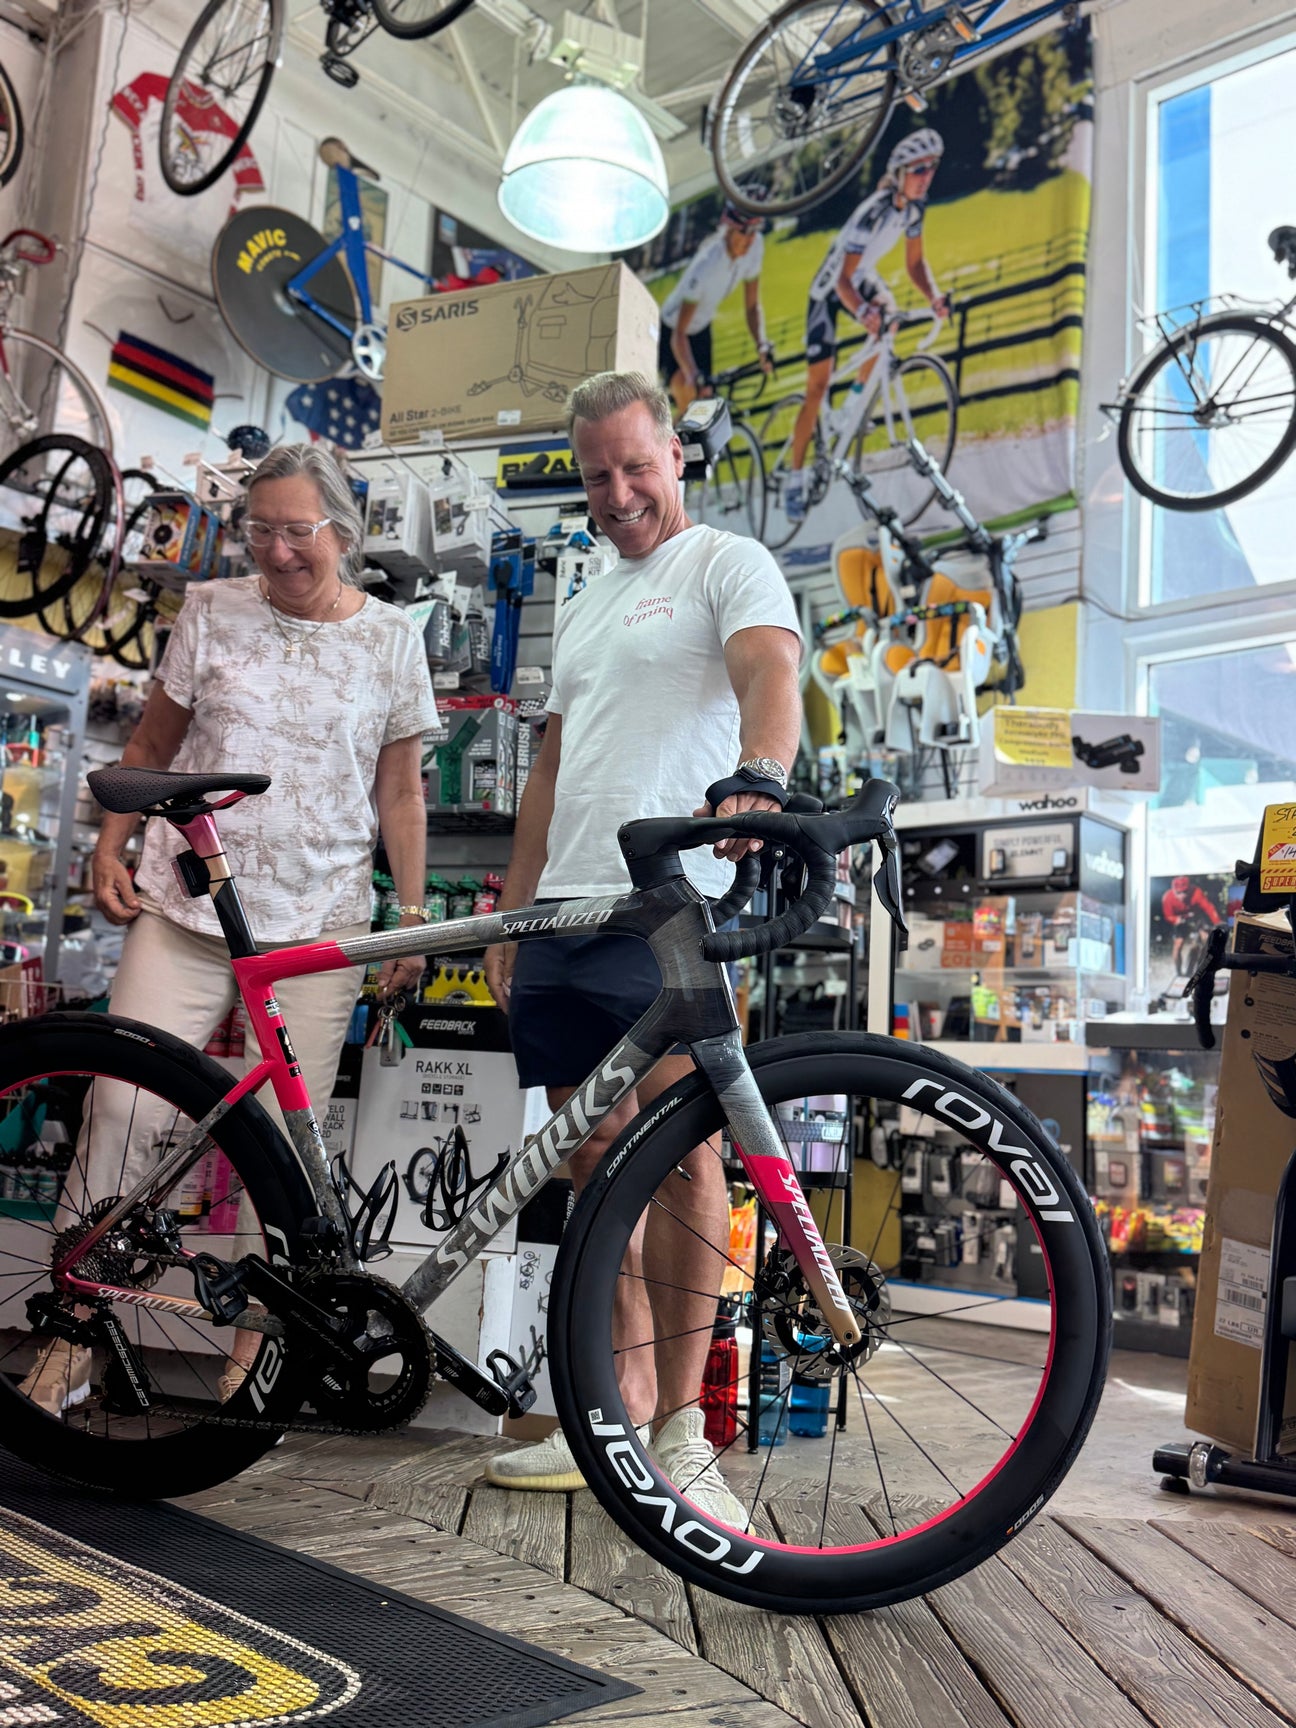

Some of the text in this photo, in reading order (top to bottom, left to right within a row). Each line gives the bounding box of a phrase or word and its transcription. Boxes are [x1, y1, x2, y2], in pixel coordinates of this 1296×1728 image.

[237, 228, 287, 275] MAVIC
[420, 300, 479, 324] SARIS
[389, 412, 404, 425] All
[406, 409, 429, 422] Star
[0, 645, 71, 679] LEY
[517, 722, 531, 767] BRUSH
[1019, 794, 1077, 811] wahoo
[499, 909, 614, 935] SPECIALIZED
[419, 1019, 477, 1032] FEEDBACK
[415, 1060, 473, 1076] RAKK XL
[328, 1104, 345, 1113] ELO
[323, 1121, 344, 1130] RACK
[605, 1095, 683, 1180] CONTINENTAL
[436, 1045, 636, 1274] S-WORKS
[901, 1078, 1075, 1223] roval
[777, 1168, 850, 1312] SPECIALIZED
[98, 1287, 206, 1317] SPECIALIZED
[103, 1320, 150, 1407] ceramicspeed
[591, 1423, 765, 1575] roval
